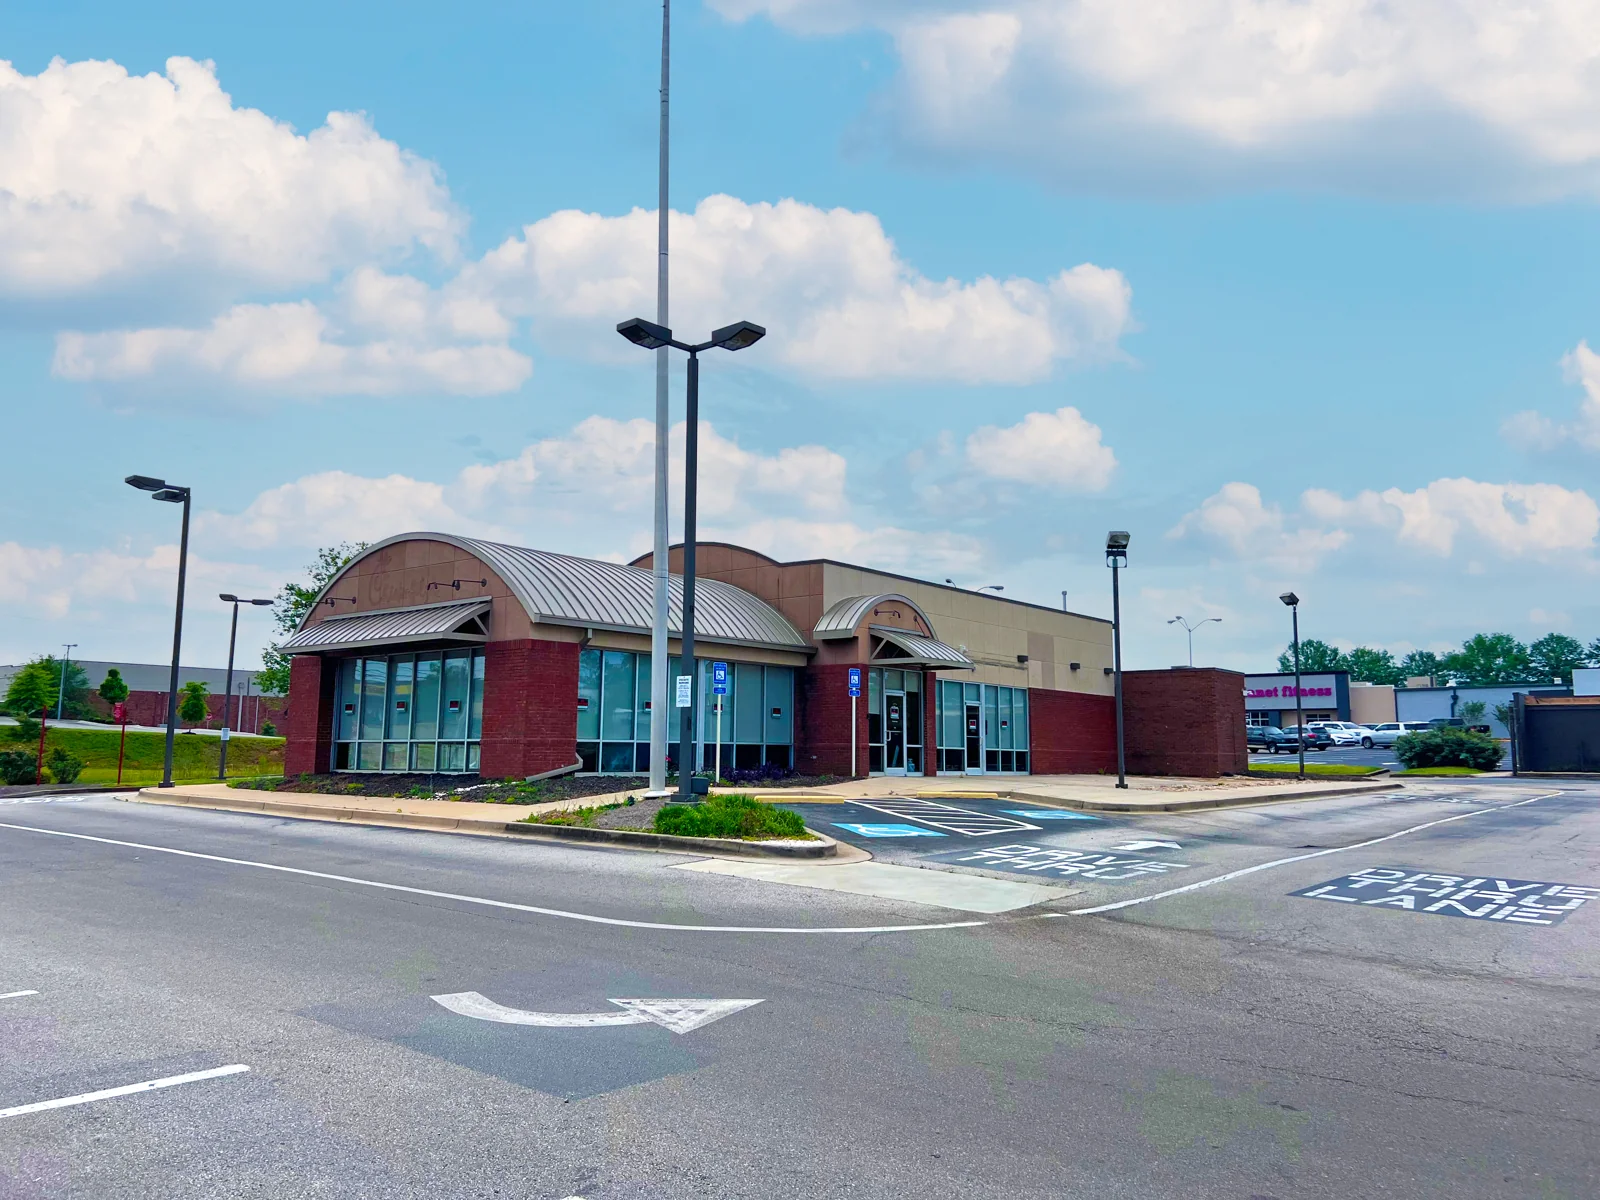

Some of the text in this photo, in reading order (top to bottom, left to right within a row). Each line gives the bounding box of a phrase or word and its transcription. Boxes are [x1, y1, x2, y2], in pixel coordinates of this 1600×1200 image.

[957, 852, 1149, 879] THRU
[981, 844, 1191, 873] DRIVE
[1347, 868, 1600, 900] DRIVE
[1347, 876, 1588, 910] THRU
[1302, 885, 1564, 925] LANE
